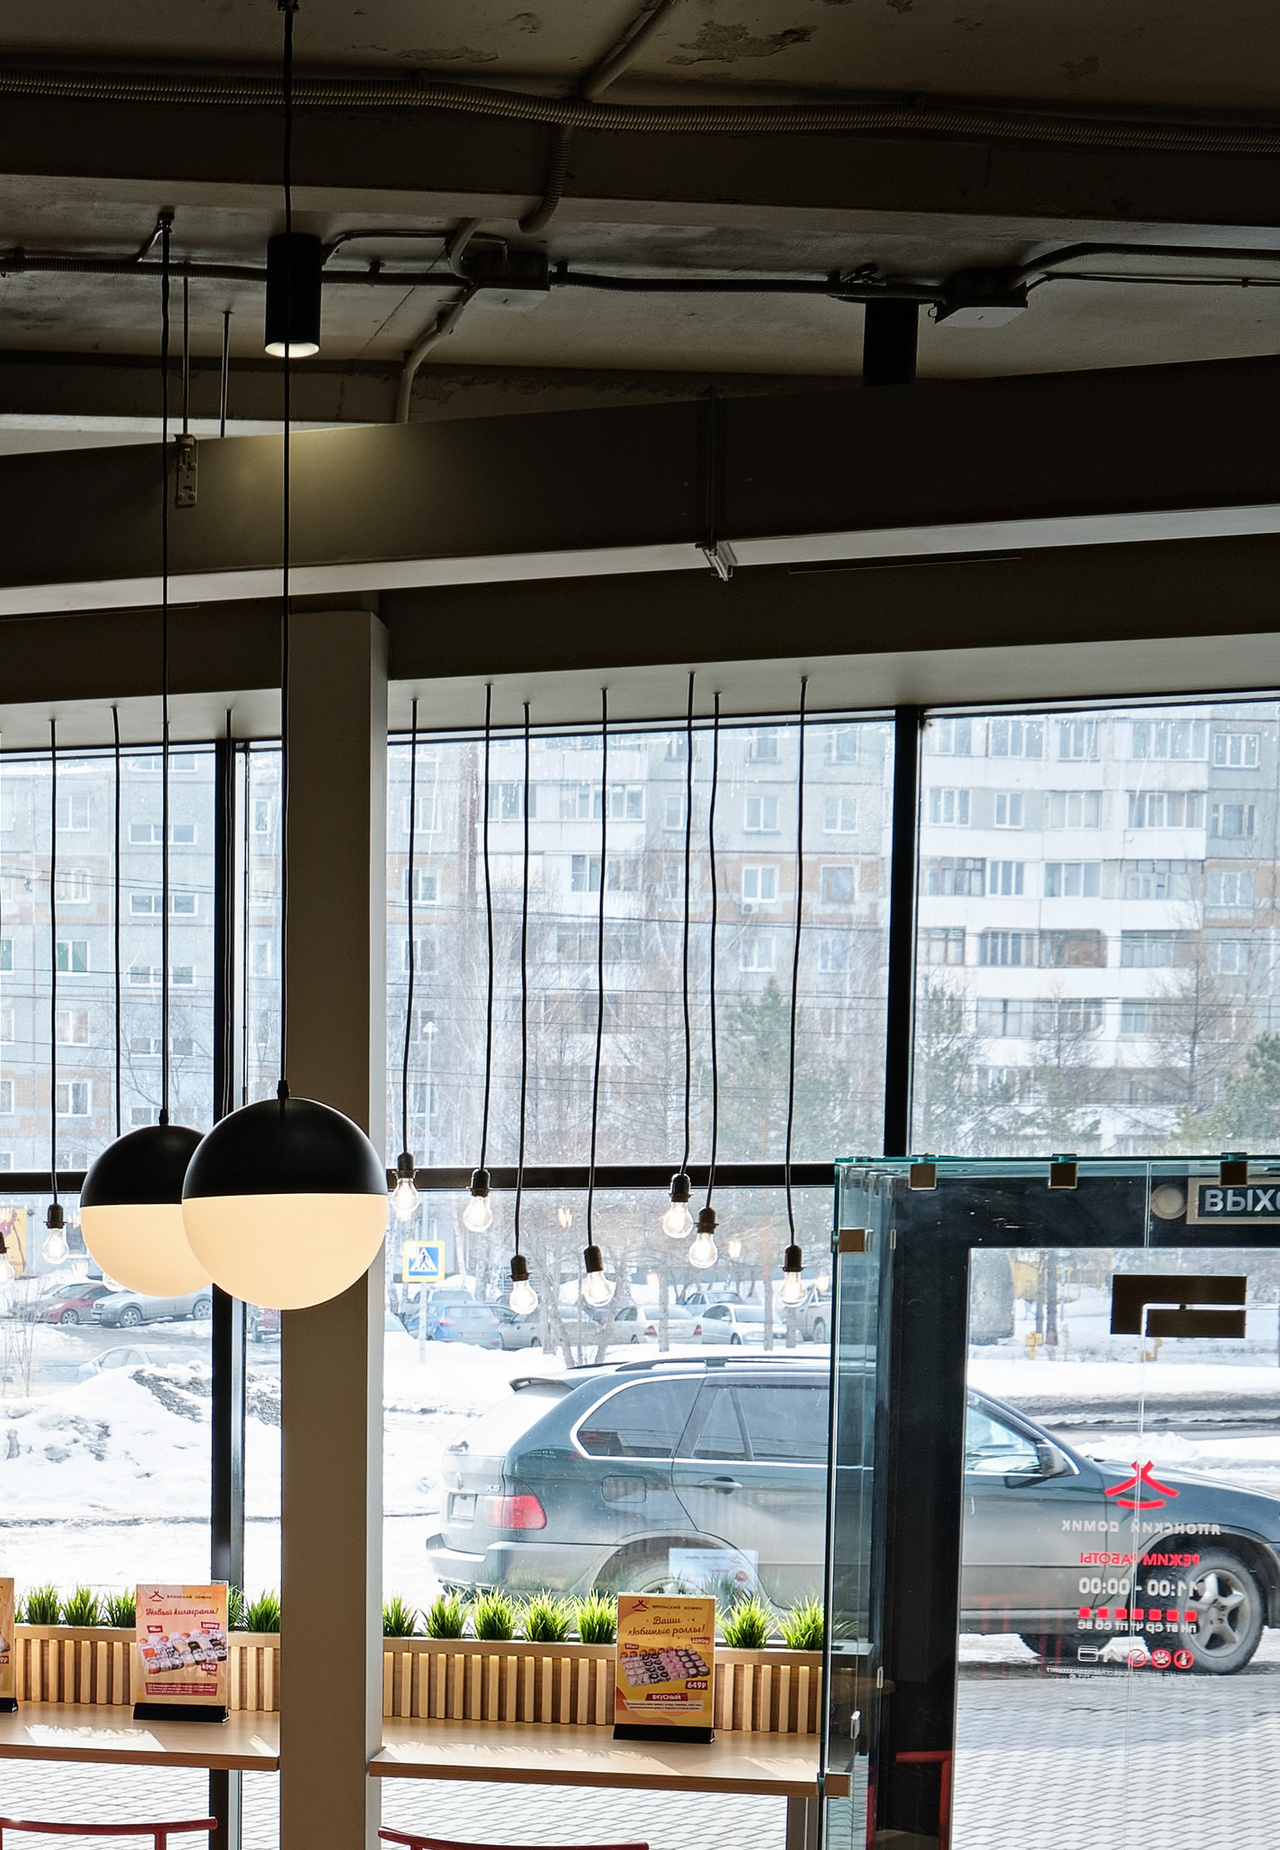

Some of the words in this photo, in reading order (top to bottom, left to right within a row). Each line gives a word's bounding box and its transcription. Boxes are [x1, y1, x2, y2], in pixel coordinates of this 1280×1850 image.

[1205, 1189, 1280, 1211] ВЫХ
[145, 1607, 173, 1616] Новый
[653, 1616, 681, 1625] Ваши
[628, 1627, 670, 1636] любимые
[671, 1624, 705, 1637] роллы!
